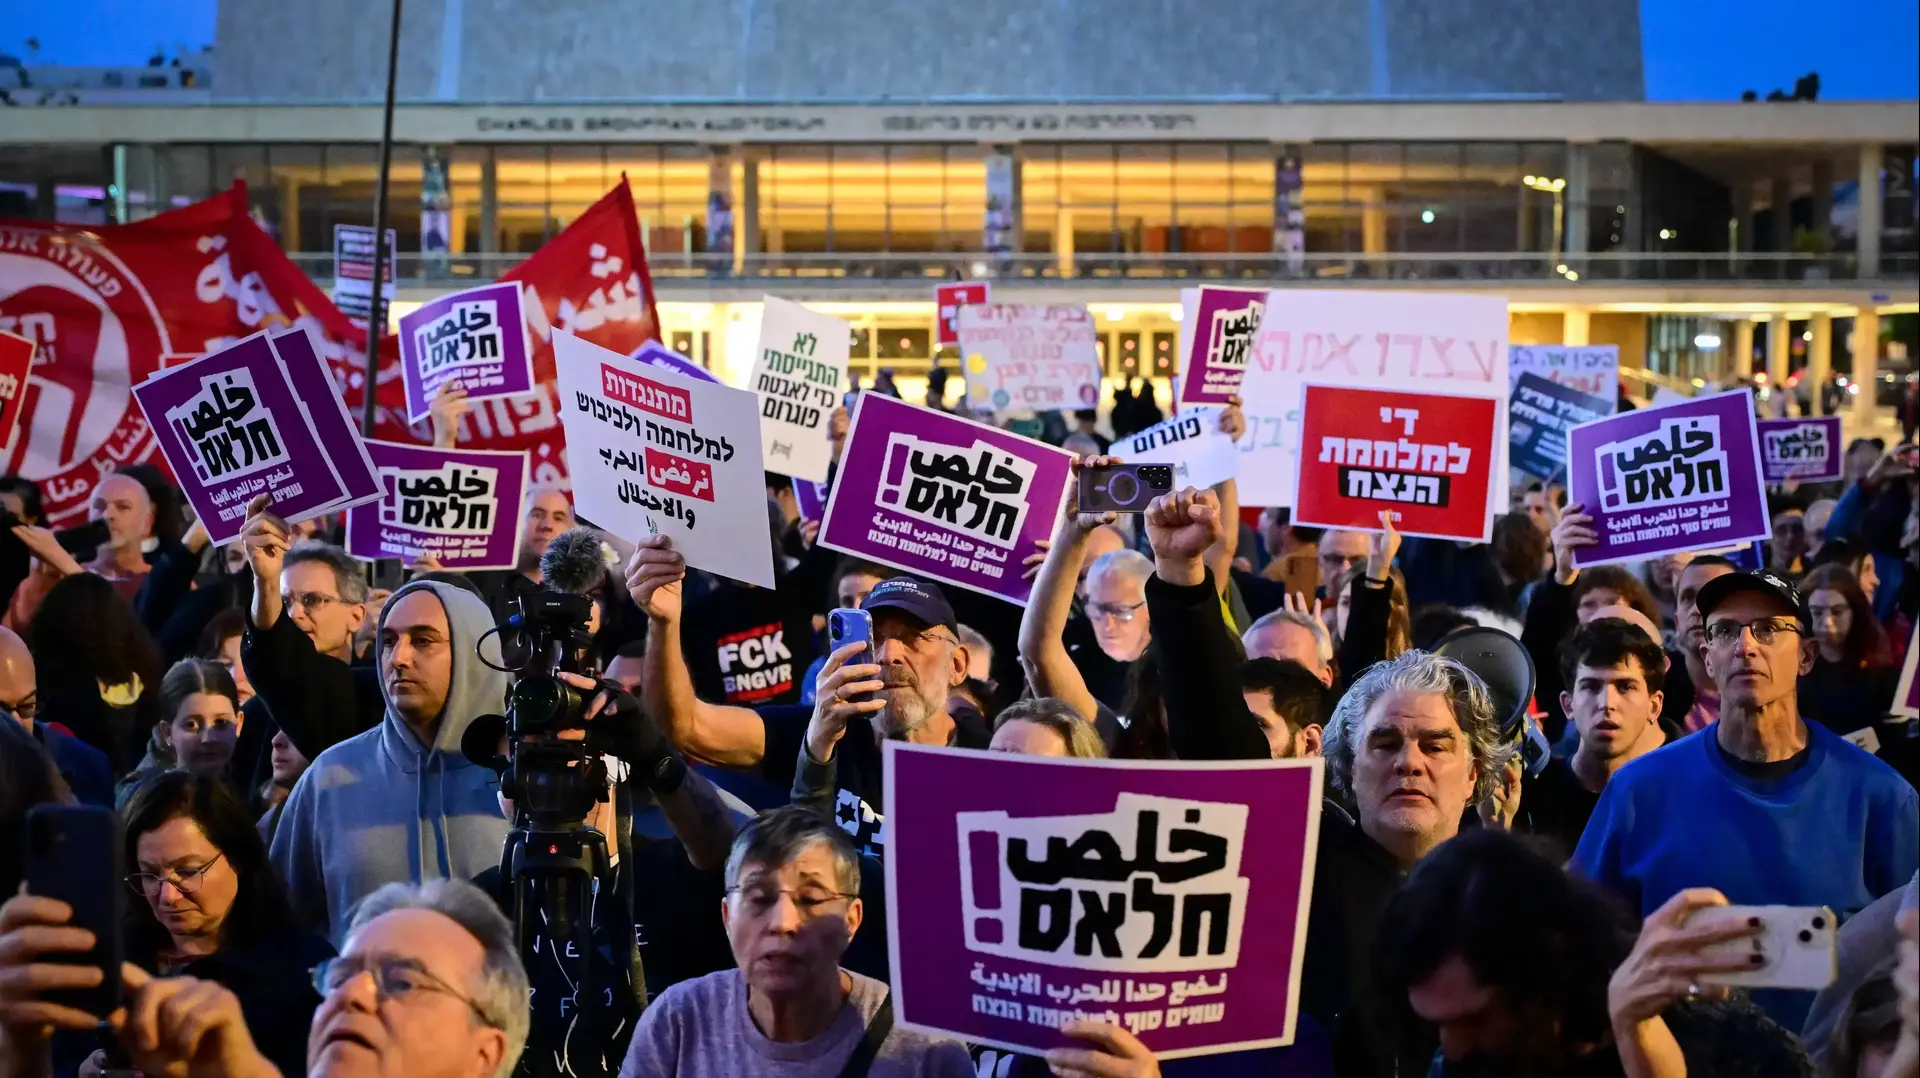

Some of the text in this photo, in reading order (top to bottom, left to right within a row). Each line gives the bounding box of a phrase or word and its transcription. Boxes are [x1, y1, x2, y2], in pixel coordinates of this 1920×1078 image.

[427, 304, 492, 345] خلص
[793, 331, 818, 356] לא
[763, 348, 839, 388] התגייסתי
[1296, 333, 1362, 375] את
[1376, 333, 1499, 382] עצרו
[182, 375, 256, 441] خلص
[605, 368, 687, 418] מתנגדות
[758, 374, 835, 408] כדי לאבטח
[576, 391, 641, 437] ולכיבוש
[763, 397, 820, 429] פוגרום
[1380, 406, 1419, 436] די
[645, 420, 734, 462] למלחמה
[1133, 417, 1201, 454] פוגרום
[1617, 420, 1714, 472] خلص
[599, 447, 645, 474] الحرب
[910, 450, 1023, 494] خلص
[1319, 436, 1471, 474] למלחמת
[271, 482, 304, 503] שמים
[398, 469, 489, 499] خلص
[650, 458, 709, 496] نرفض
[1348, 470, 1440, 504] הנצח
[617, 479, 696, 530] والاحتلال
[913, 528, 951, 546] للحرب
[952, 536, 974, 552] حدا
[1608, 515, 1731, 546] שמים סוף למלחמת הנצח
[867, 529, 1004, 579] שמים סוף למלחמת הנצח
[718, 630, 792, 673] FCK
[1006, 808, 1229, 885] خلص
[969, 961, 1228, 1006] نضع حدا للحرب الابدية
[972, 993, 1023, 1021] הנצח
[1124, 1009, 1163, 1036] סוף
[1165, 1002, 1225, 1028] שמים
